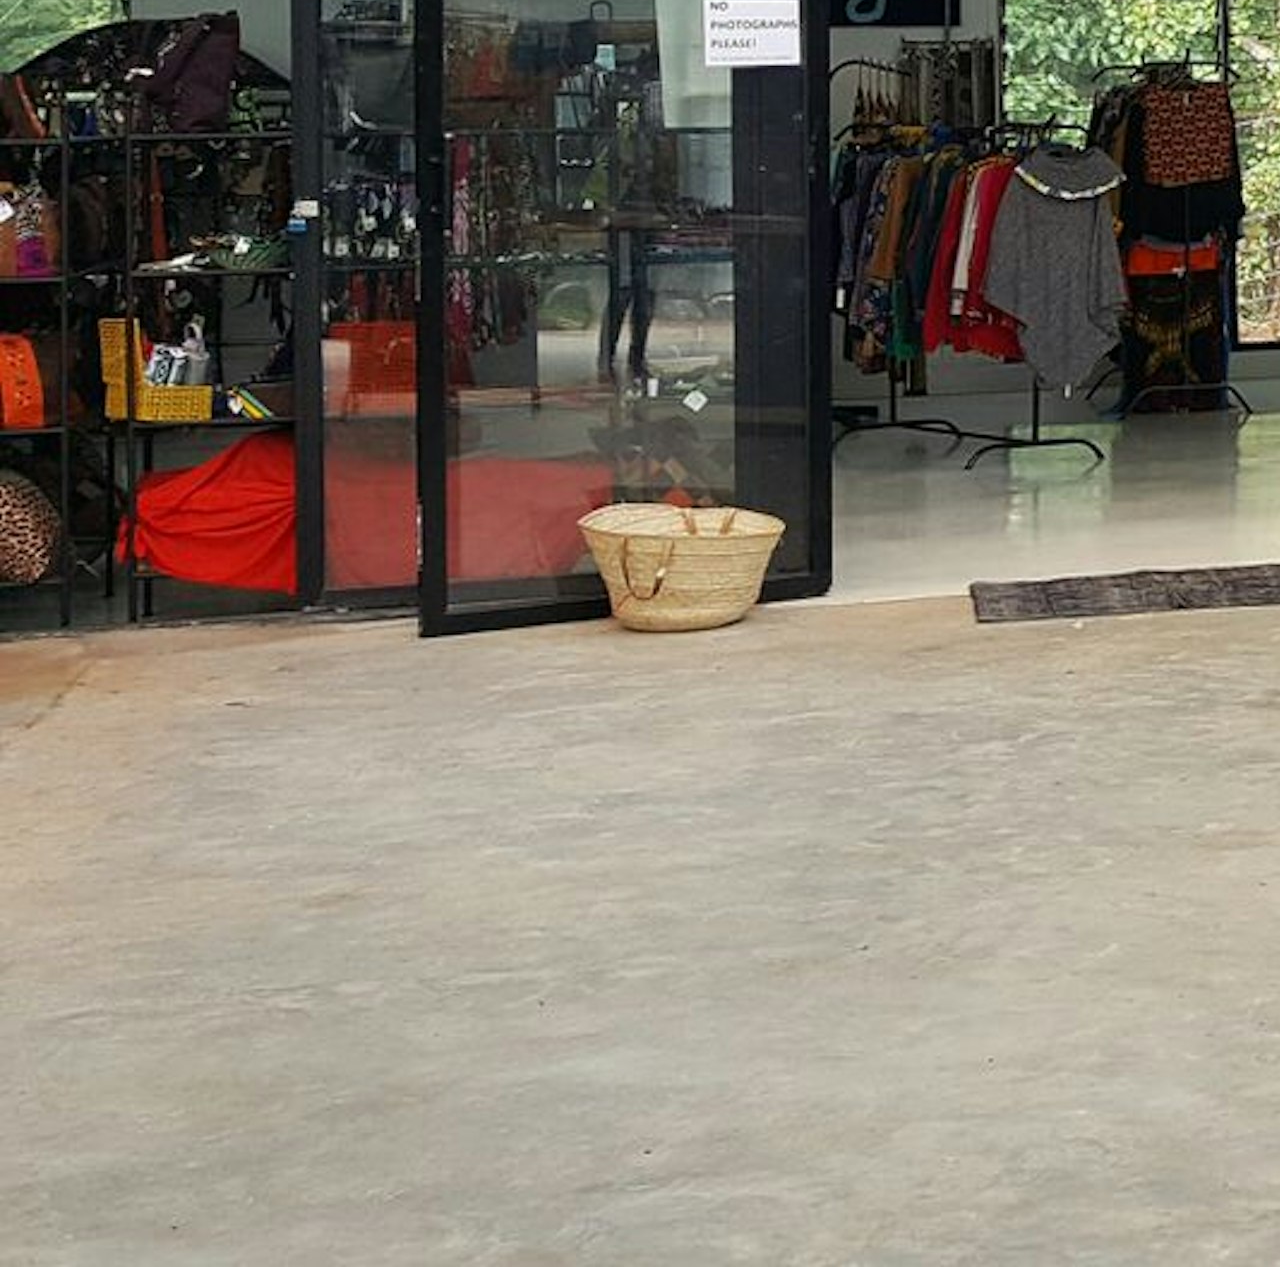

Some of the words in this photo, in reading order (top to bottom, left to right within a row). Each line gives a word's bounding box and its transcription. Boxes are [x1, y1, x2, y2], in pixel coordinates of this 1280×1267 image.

[709, 1, 729, 12] NO
[709, 18, 798, 30] PHOTOGRAPHS
[709, 37, 757, 49] PLEASE!
